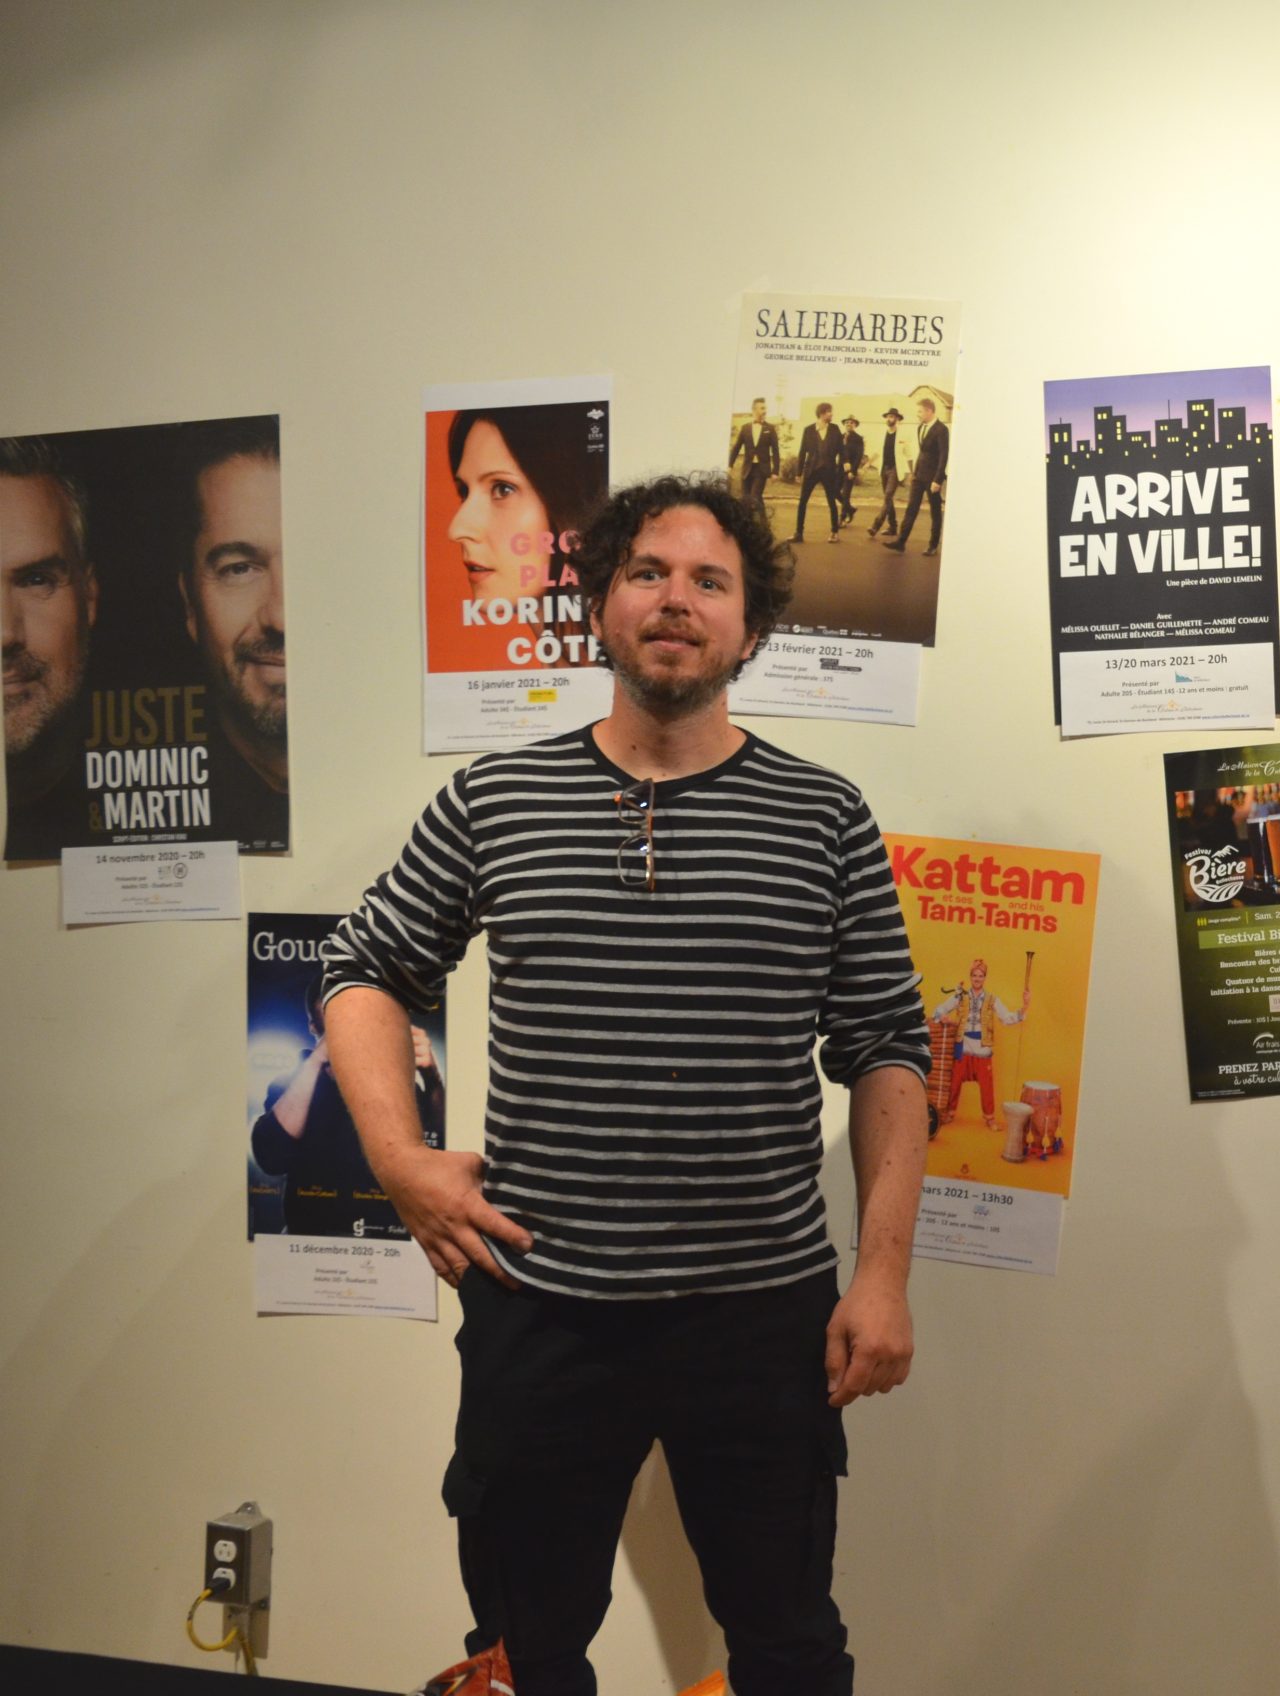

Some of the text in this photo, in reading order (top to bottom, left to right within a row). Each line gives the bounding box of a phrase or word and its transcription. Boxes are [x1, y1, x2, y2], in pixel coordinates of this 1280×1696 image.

[755, 308, 944, 345] SALEBARBES
[755, 342, 796, 351] JONATHAN
[823, 345, 867, 353] PAINCHAUD
[874, 347, 899, 355] KEVIN
[900, 348, 942, 357] MCINTYRE
[764, 353, 794, 361] GEORGE
[795, 354, 837, 363] BELLIVEAU
[903, 360, 929, 368] BREAU
[510, 530, 583, 556] GRO
[1059, 532, 1118, 578] EN
[520, 563, 580, 588] PLA
[1166, 574, 1262, 588] Une pièce de DAVID LEMELIN
[463, 594, 584, 626] KORIN
[1061, 615, 1269, 634] MÉLISSA OUELLET DANIEL GUILLEMETTE ANDRÉ COMEAU
[1094, 626, 1236, 641] NATHALIE BÉLANGER MÉLISSA COMEAU
[768, 643, 874, 658] 13 février 2021 20h
[1105, 653, 1227, 671] 13/20 mars 2021 20h
[467, 677, 570, 692] 16 janvier 2021 20h
[1122, 680, 1160, 689] Présenté par
[85, 686, 208, 748] JUSTE
[86, 746, 208, 789] DOMINIC
[103, 788, 211, 831] MARTIN
[96, 850, 205, 864] 14 novembre 2020 20h
[893, 845, 1085, 905] Kattam
[1186, 855, 1246, 886] Bière
[917, 895, 1058, 934] Tam-Tams
[1008, 902, 1027, 911] and
[1029, 902, 1044, 912] his
[1217, 927, 1266, 945] Festival
[1220, 959, 1257, 968] Rencontre
[1258, 957, 1271, 966] des
[1256, 976, 1265, 984] de
[1252, 985, 1259, 993] la
[1218, 1063, 1259, 1075] PRENEZ
[1242, 1073, 1266, 1085] votre
[944, 1187, 969, 1199] 2021
[982, 1192, 1014, 1205] 13h30
[289, 1243, 401, 1257] 11 décembre 2020 20h
